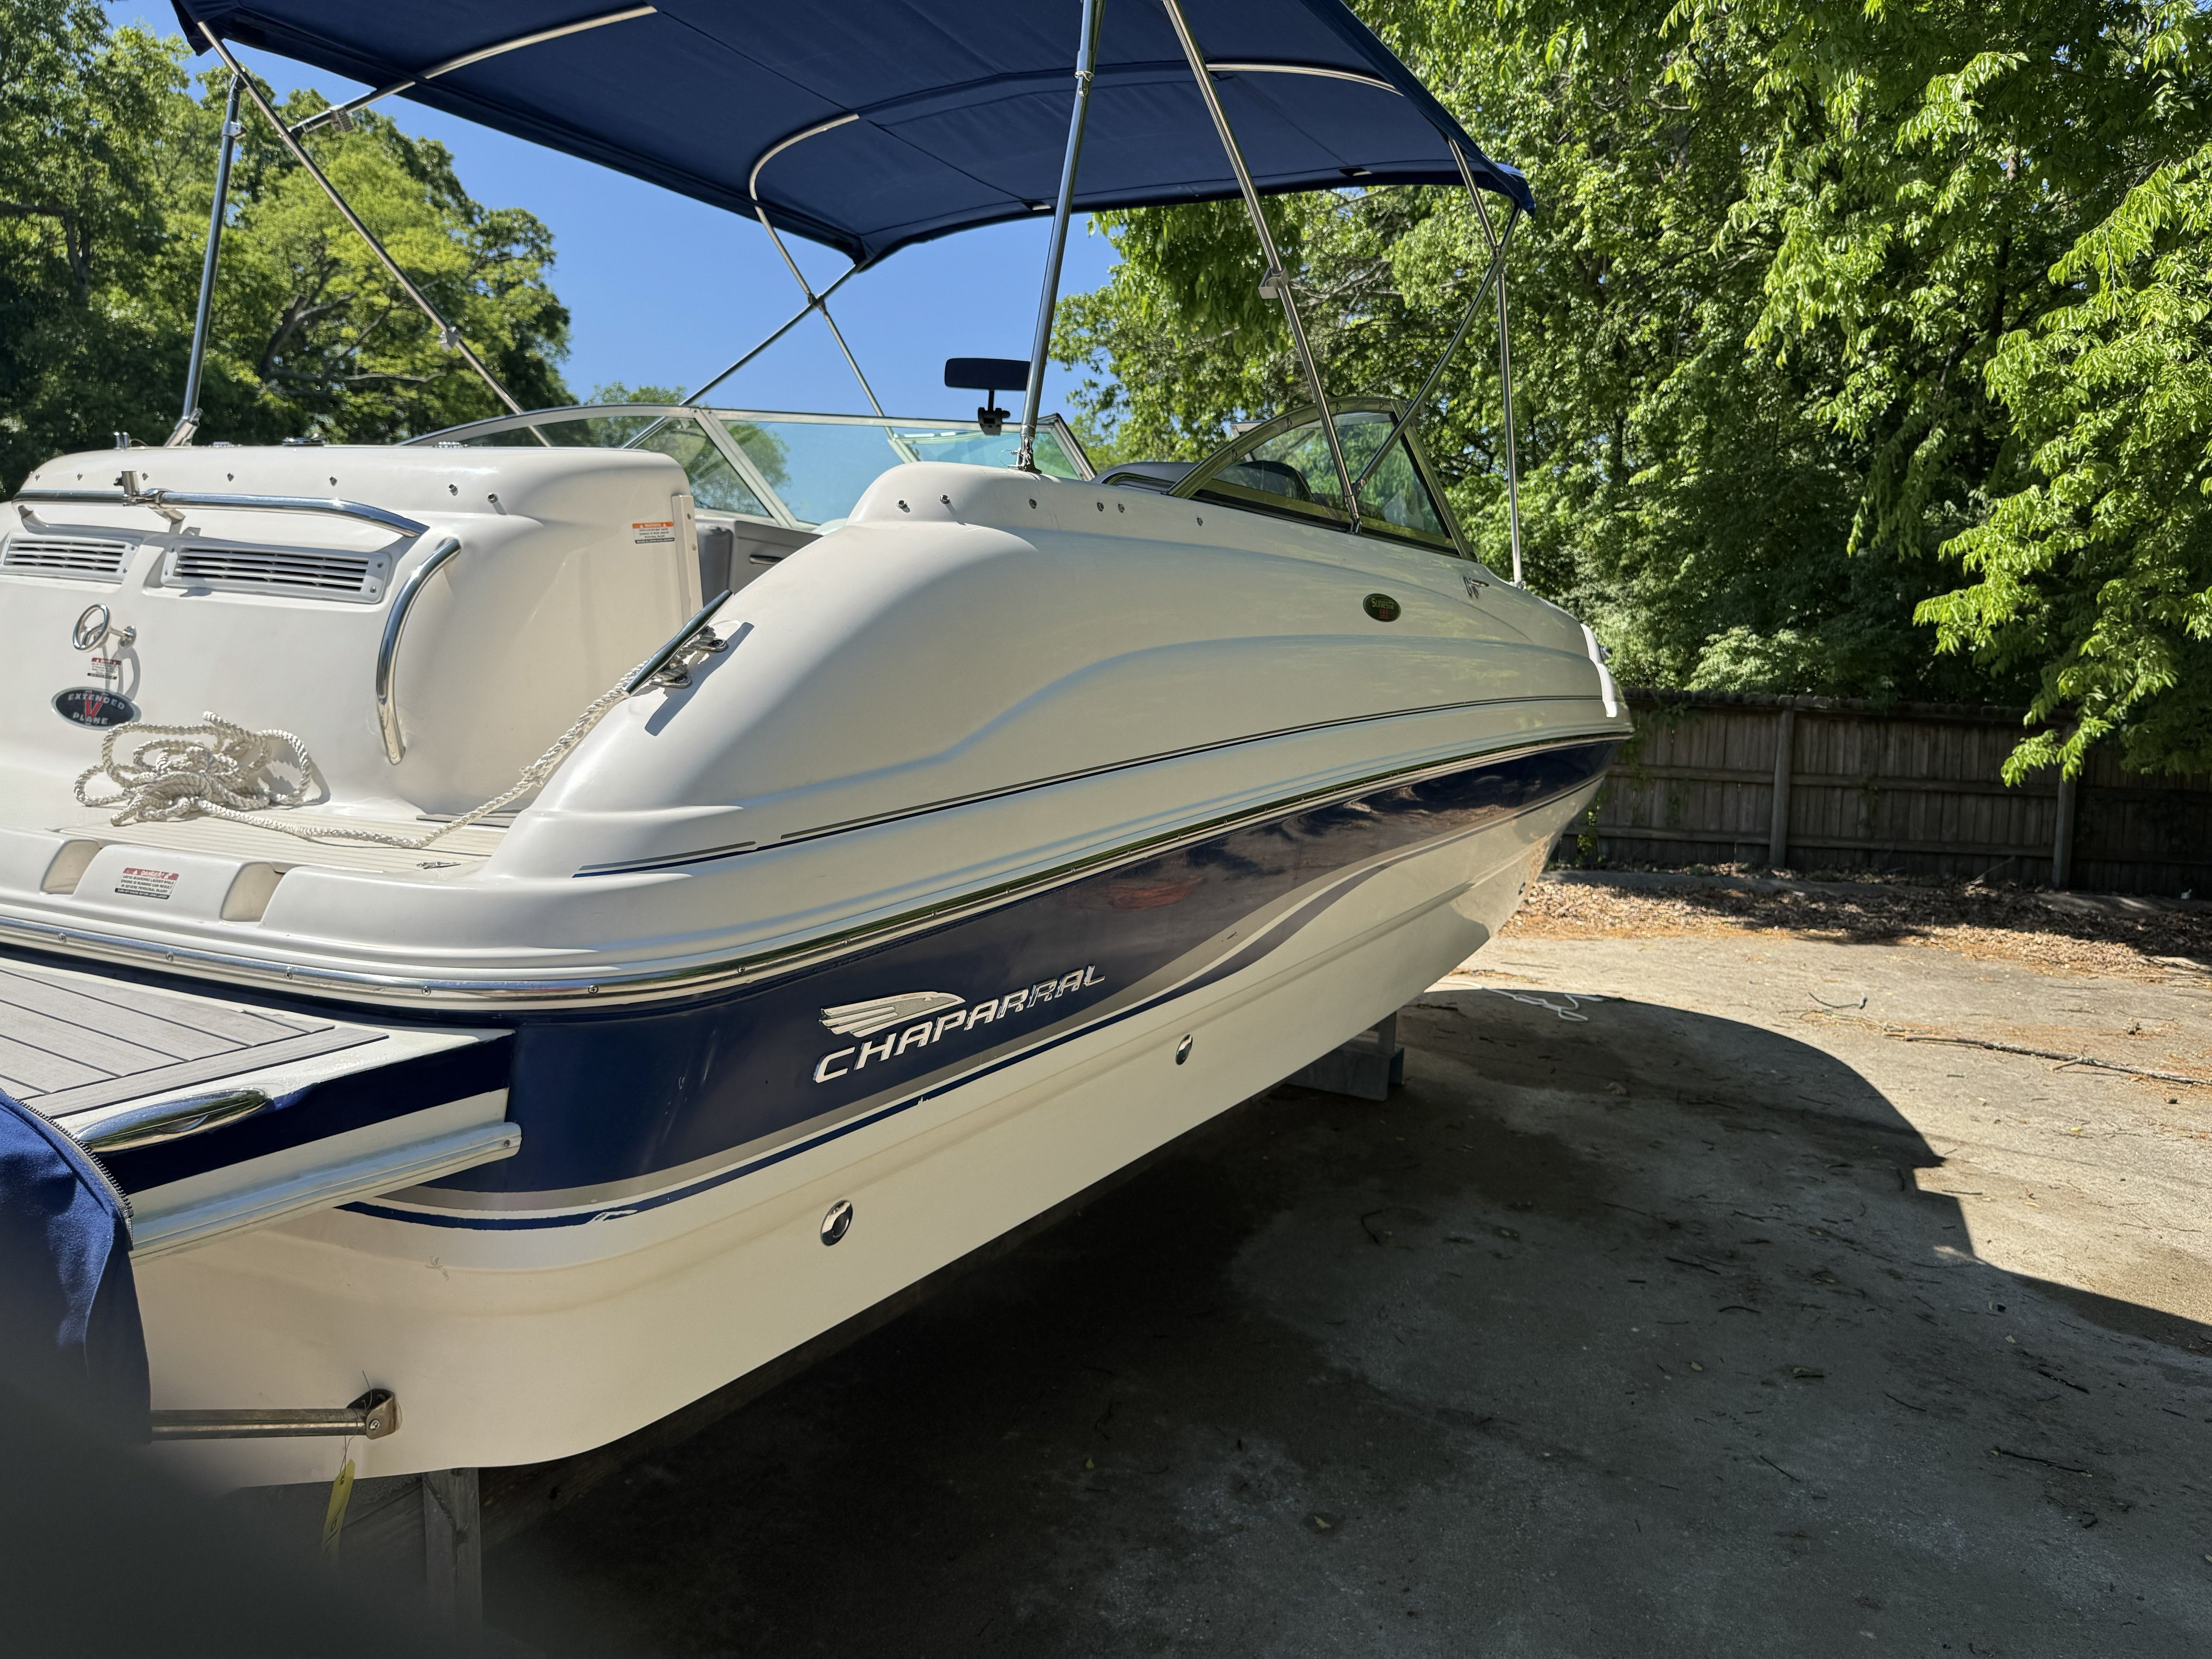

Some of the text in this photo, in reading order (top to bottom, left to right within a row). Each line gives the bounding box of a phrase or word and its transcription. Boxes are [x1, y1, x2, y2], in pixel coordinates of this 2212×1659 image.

[1371, 598, 1394, 610] Sunesta
[68, 693, 125, 710] EXTENDED
[73, 712, 108, 725] PLANE
[814, 965, 1105, 1084] CHAPARRAL
